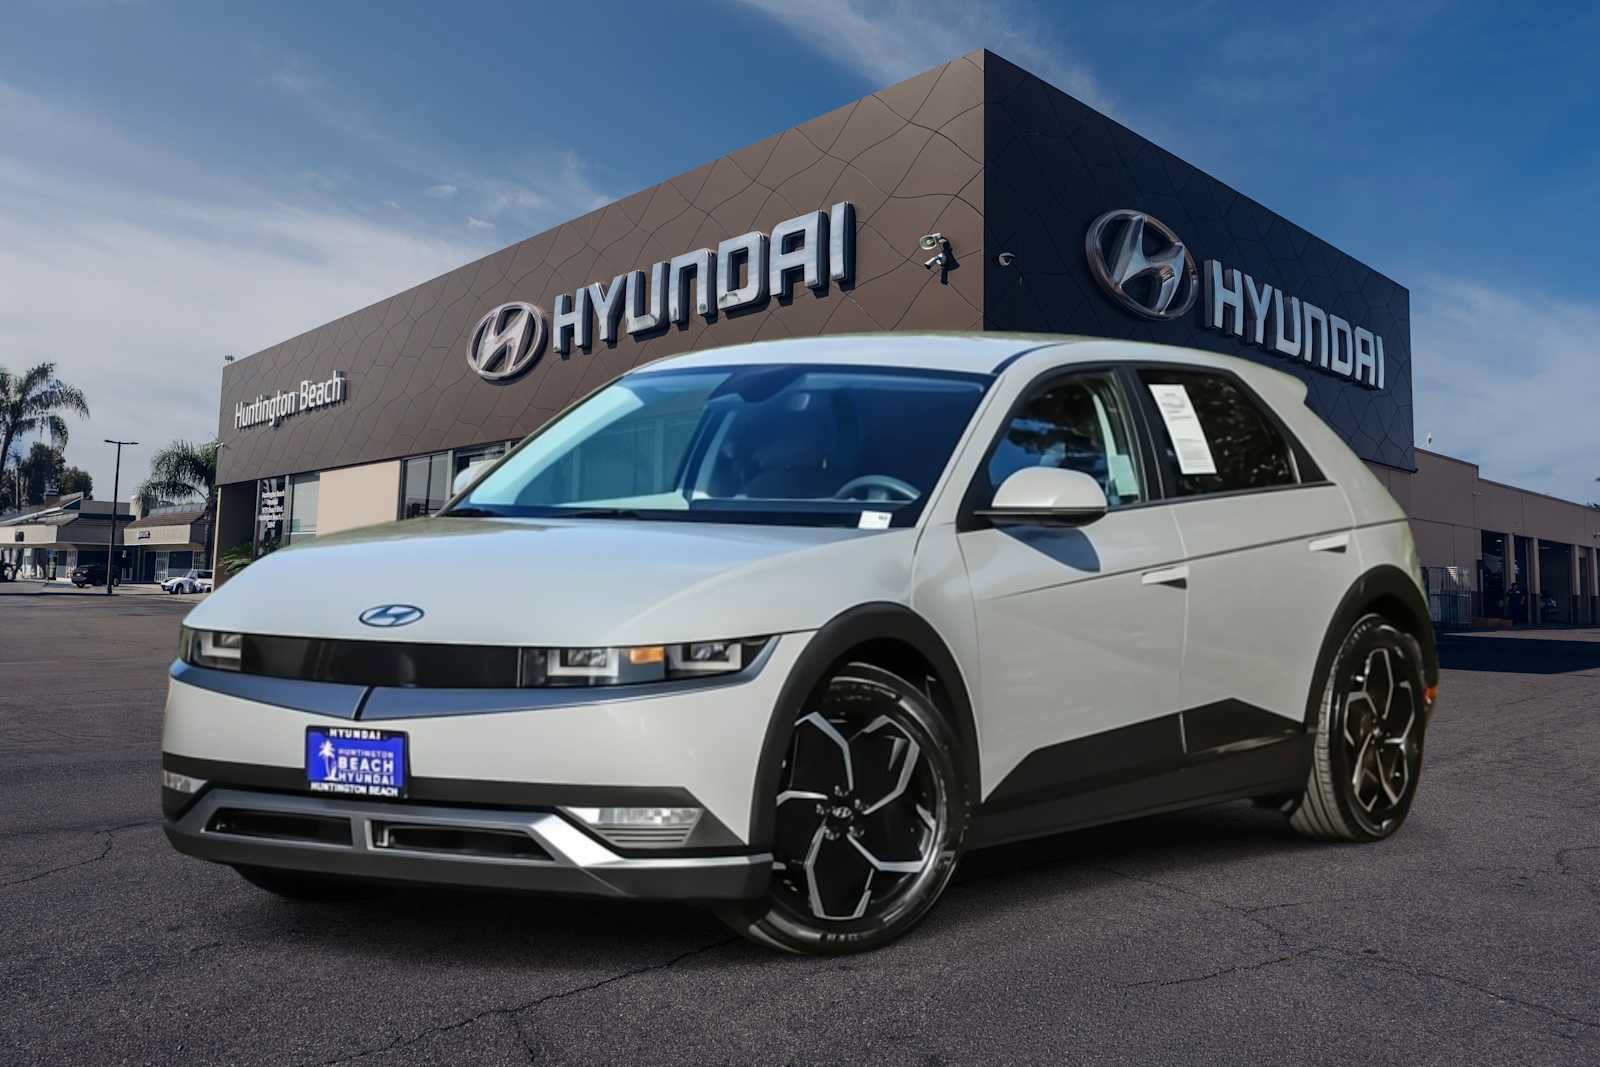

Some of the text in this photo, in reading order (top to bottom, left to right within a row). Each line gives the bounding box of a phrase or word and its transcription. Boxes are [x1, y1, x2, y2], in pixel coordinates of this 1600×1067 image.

[553, 201, 854, 356] HYUNDAI
[1206, 259, 1385, 389] HYUNDAI
[235, 370, 343, 430] Huntington Beach
[329, 728, 381, 740] HYUNDAI
[338, 748, 394, 759] HUNTINGTON
[338, 756, 394, 773] BEACH
[338, 772, 395, 785] HYUNDAI
[310, 781, 399, 797] HUNTINGTON BEACH
